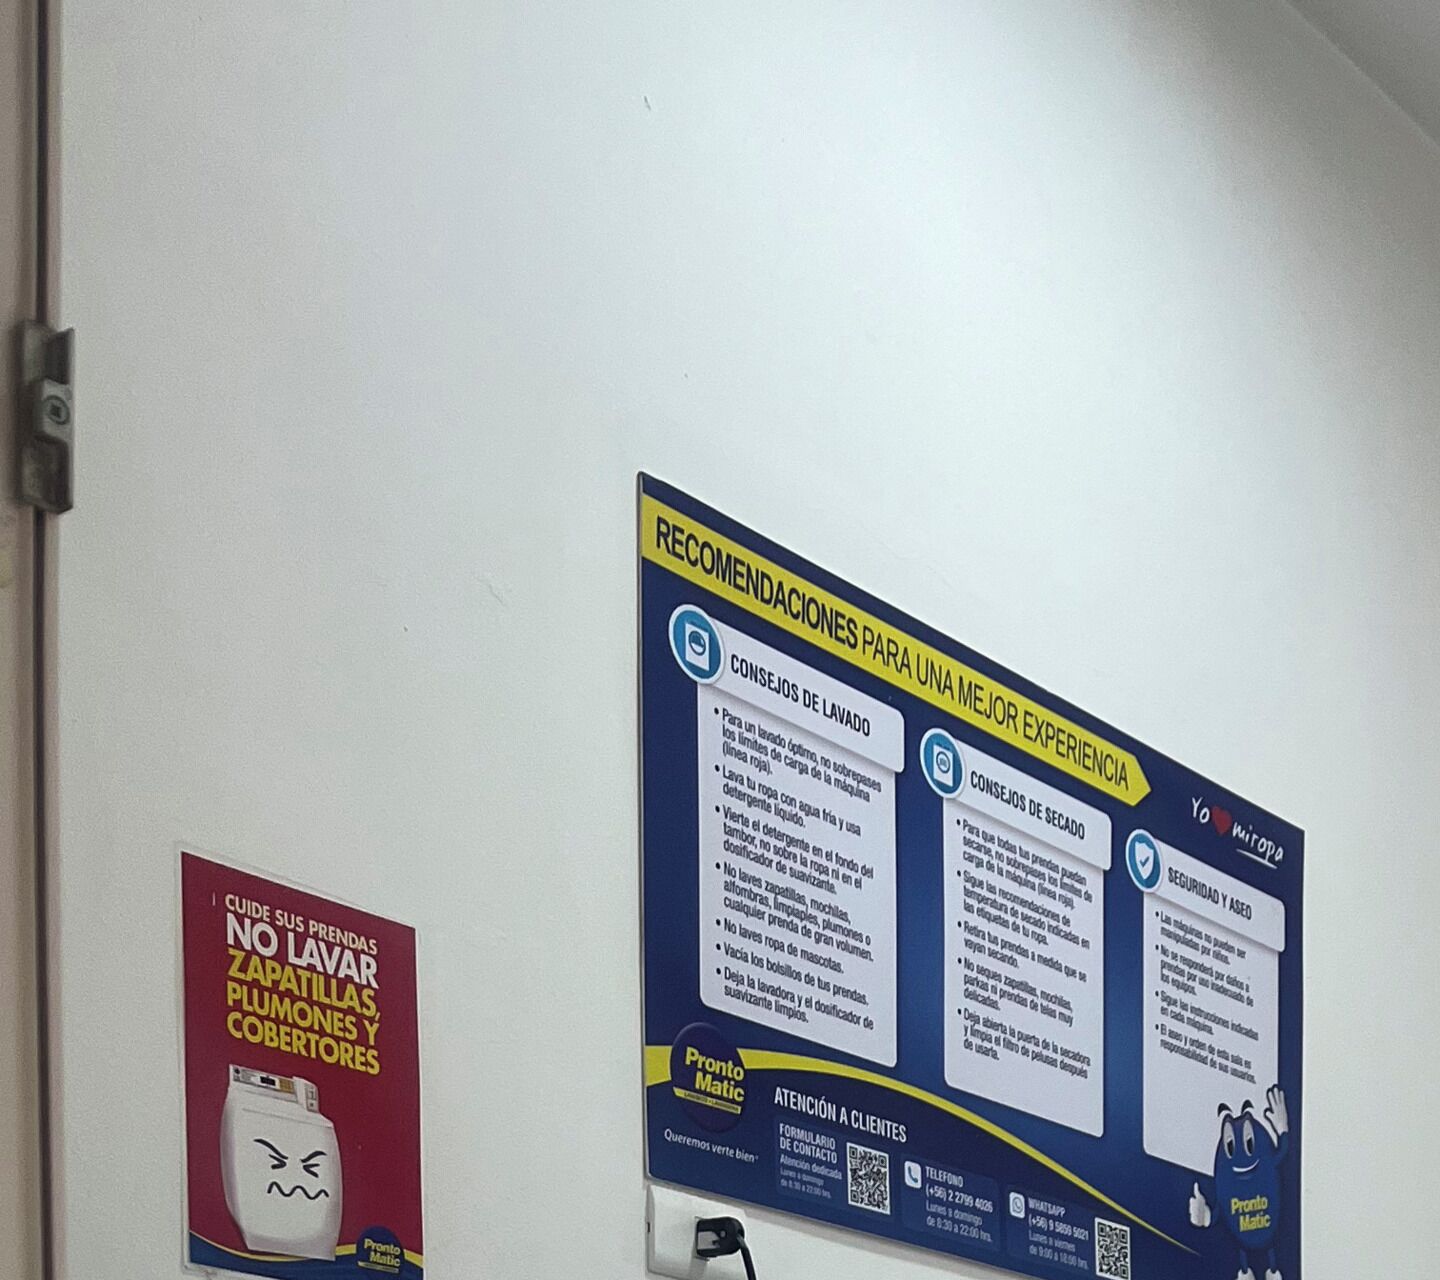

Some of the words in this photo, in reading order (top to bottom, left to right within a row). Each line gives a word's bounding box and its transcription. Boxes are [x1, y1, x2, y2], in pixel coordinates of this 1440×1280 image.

[655, 514, 859, 650] RECOMENDACIONES
[862, 624, 912, 680] PARA
[916, 652, 955, 701] UNA
[958, 674, 1018, 734] MEJOR
[1023, 709, 1129, 791] EXPERIENCIA
[730, 653, 799, 703] CONSEJOS
[802, 688, 819, 713] DE
[822, 698, 871, 737] LAVADO
[970, 770, 1026, 812] CONSEJOS
[1028, 798, 1043, 820] DE
[1044, 806, 1085, 840] SECADO
[1191, 796, 1210, 824] Yo
[1167, 867, 1220, 905] SEGURIDAD
[1222, 893, 1227, 908] Y
[1228, 897, 1252, 920] ASEO
[225, 892, 269, 922] CUIDE
[275, 908, 304, 933] SUS
[308, 919, 377, 955] PRENDAS
[226, 912, 277, 959] NO
[287, 931, 378, 989] LAVAR
[227, 980, 358, 1041] PLUMONES
[363, 1019, 379, 1047] Y
[226, 1009, 380, 1076] COBERTORES
[685, 1046, 745, 1081] Pronto
[695, 1070, 745, 1102] Matic
[774, 1086, 837, 1122] ATENCIÓN
[839, 1106, 848, 1126] A
[850, 1109, 907, 1143] CLIENTES
[664, 1128, 711, 1151] Queremos
[711, 1144, 735, 1158] verte
[779, 1122, 836, 1151] FORMULARIO
[779, 1136, 792, 1152] DE
[793, 1140, 838, 1164] CONTACTO
[1231, 1194, 1268, 1215] Pronto
[1239, 1212, 1271, 1232] Matic
[364, 1238, 401, 1255] Pronto
[370, 1251, 401, 1267] Matic
